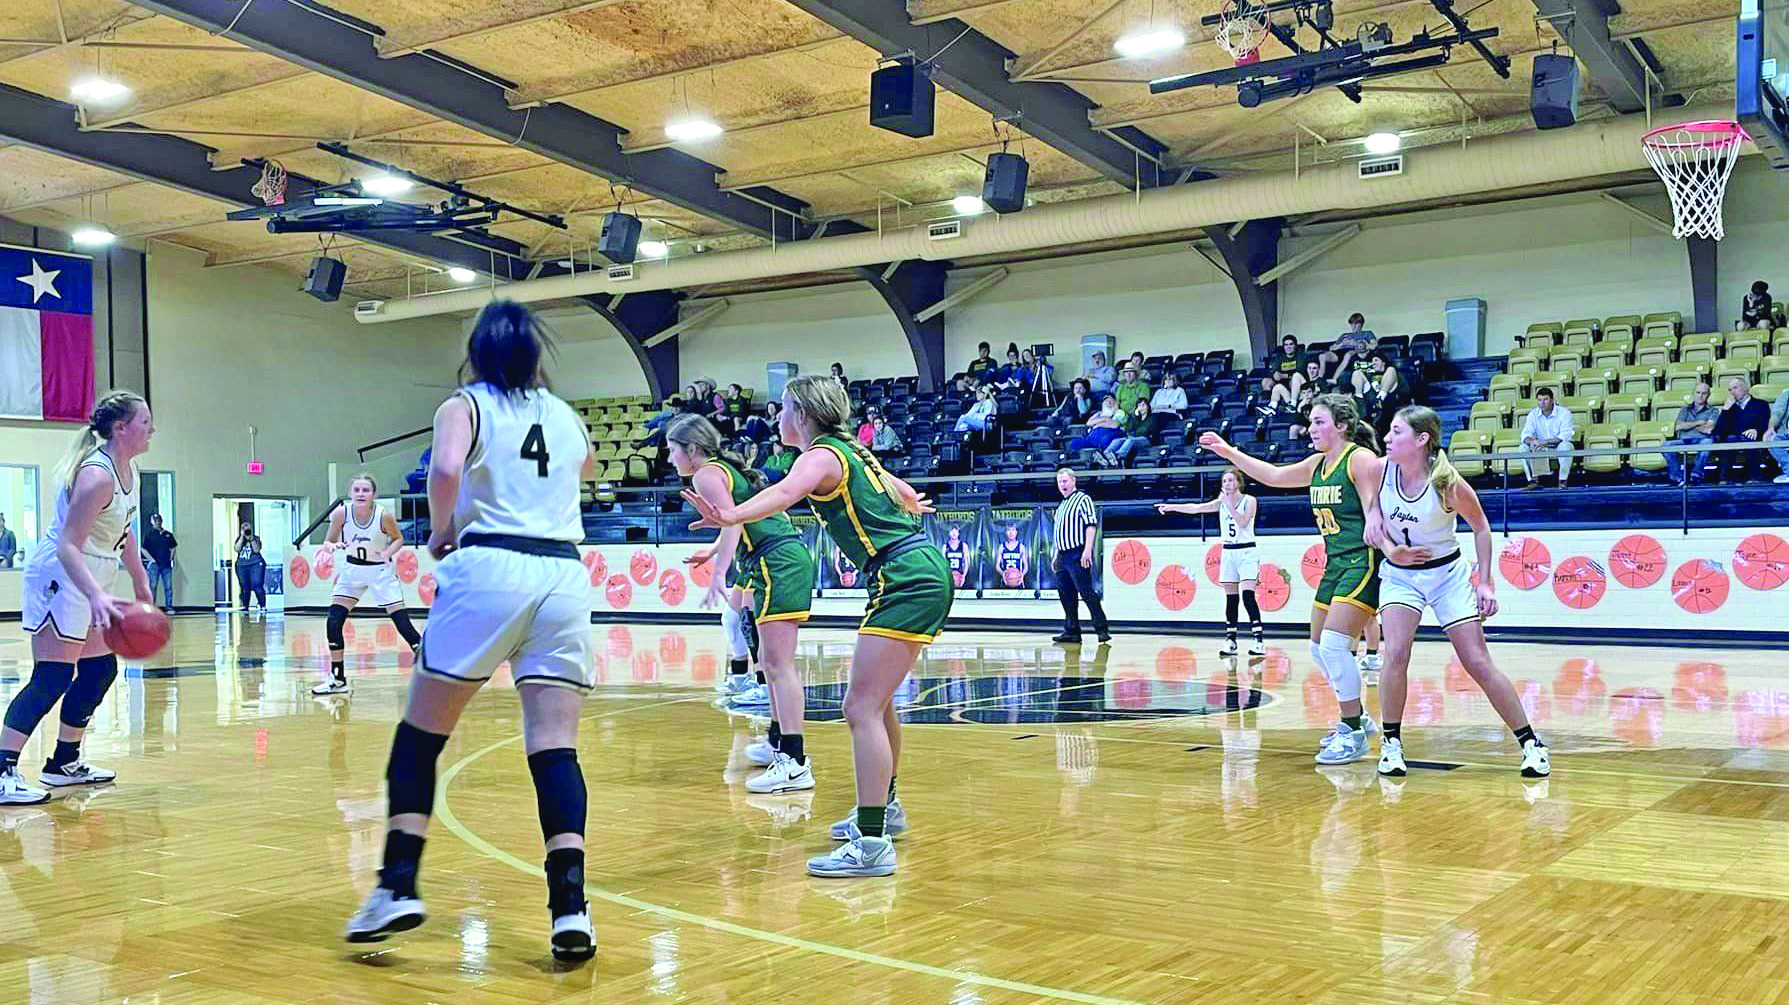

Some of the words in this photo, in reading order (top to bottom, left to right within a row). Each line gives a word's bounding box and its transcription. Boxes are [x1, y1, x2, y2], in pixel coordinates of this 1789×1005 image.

[520, 423, 550, 478] 4
[1312, 507, 1341, 536] 20
[1389, 506, 1419, 523] Jayton
[1228, 523, 1237, 538] 5
[1402, 527, 1412, 548] 1
[357, 546, 367, 561] 0
